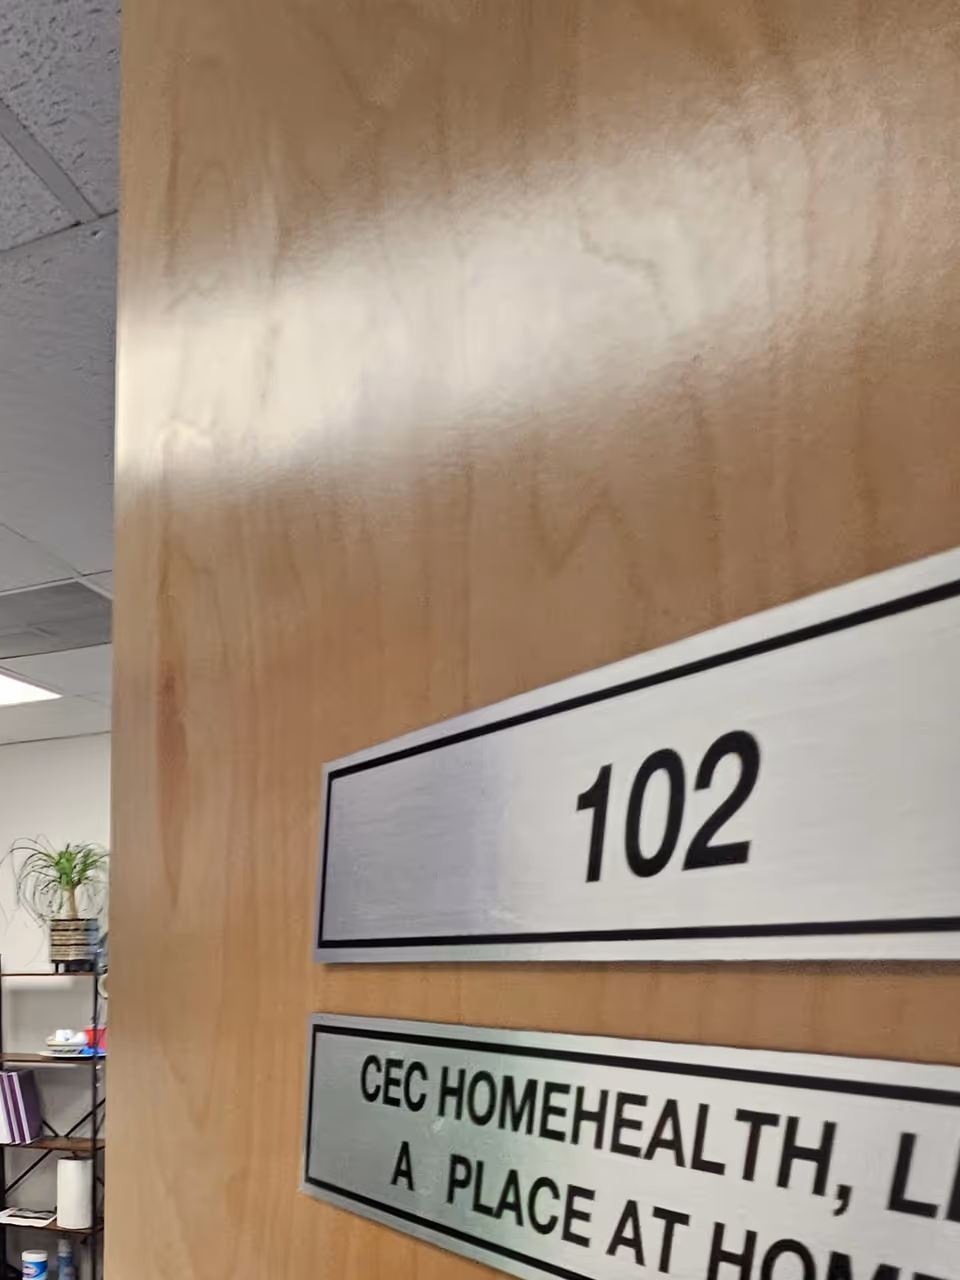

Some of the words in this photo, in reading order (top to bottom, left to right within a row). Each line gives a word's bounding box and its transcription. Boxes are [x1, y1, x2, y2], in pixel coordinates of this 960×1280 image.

[576, 730, 760, 882] 102
[361, 1055, 427, 1112] CEC
[438, 1067, 850, 1217] HOMEHEALTH,
[390, 1141, 414, 1191] A
[447, 1154, 596, 1248] PLACE
[606, 1200, 690, 1274] AT
